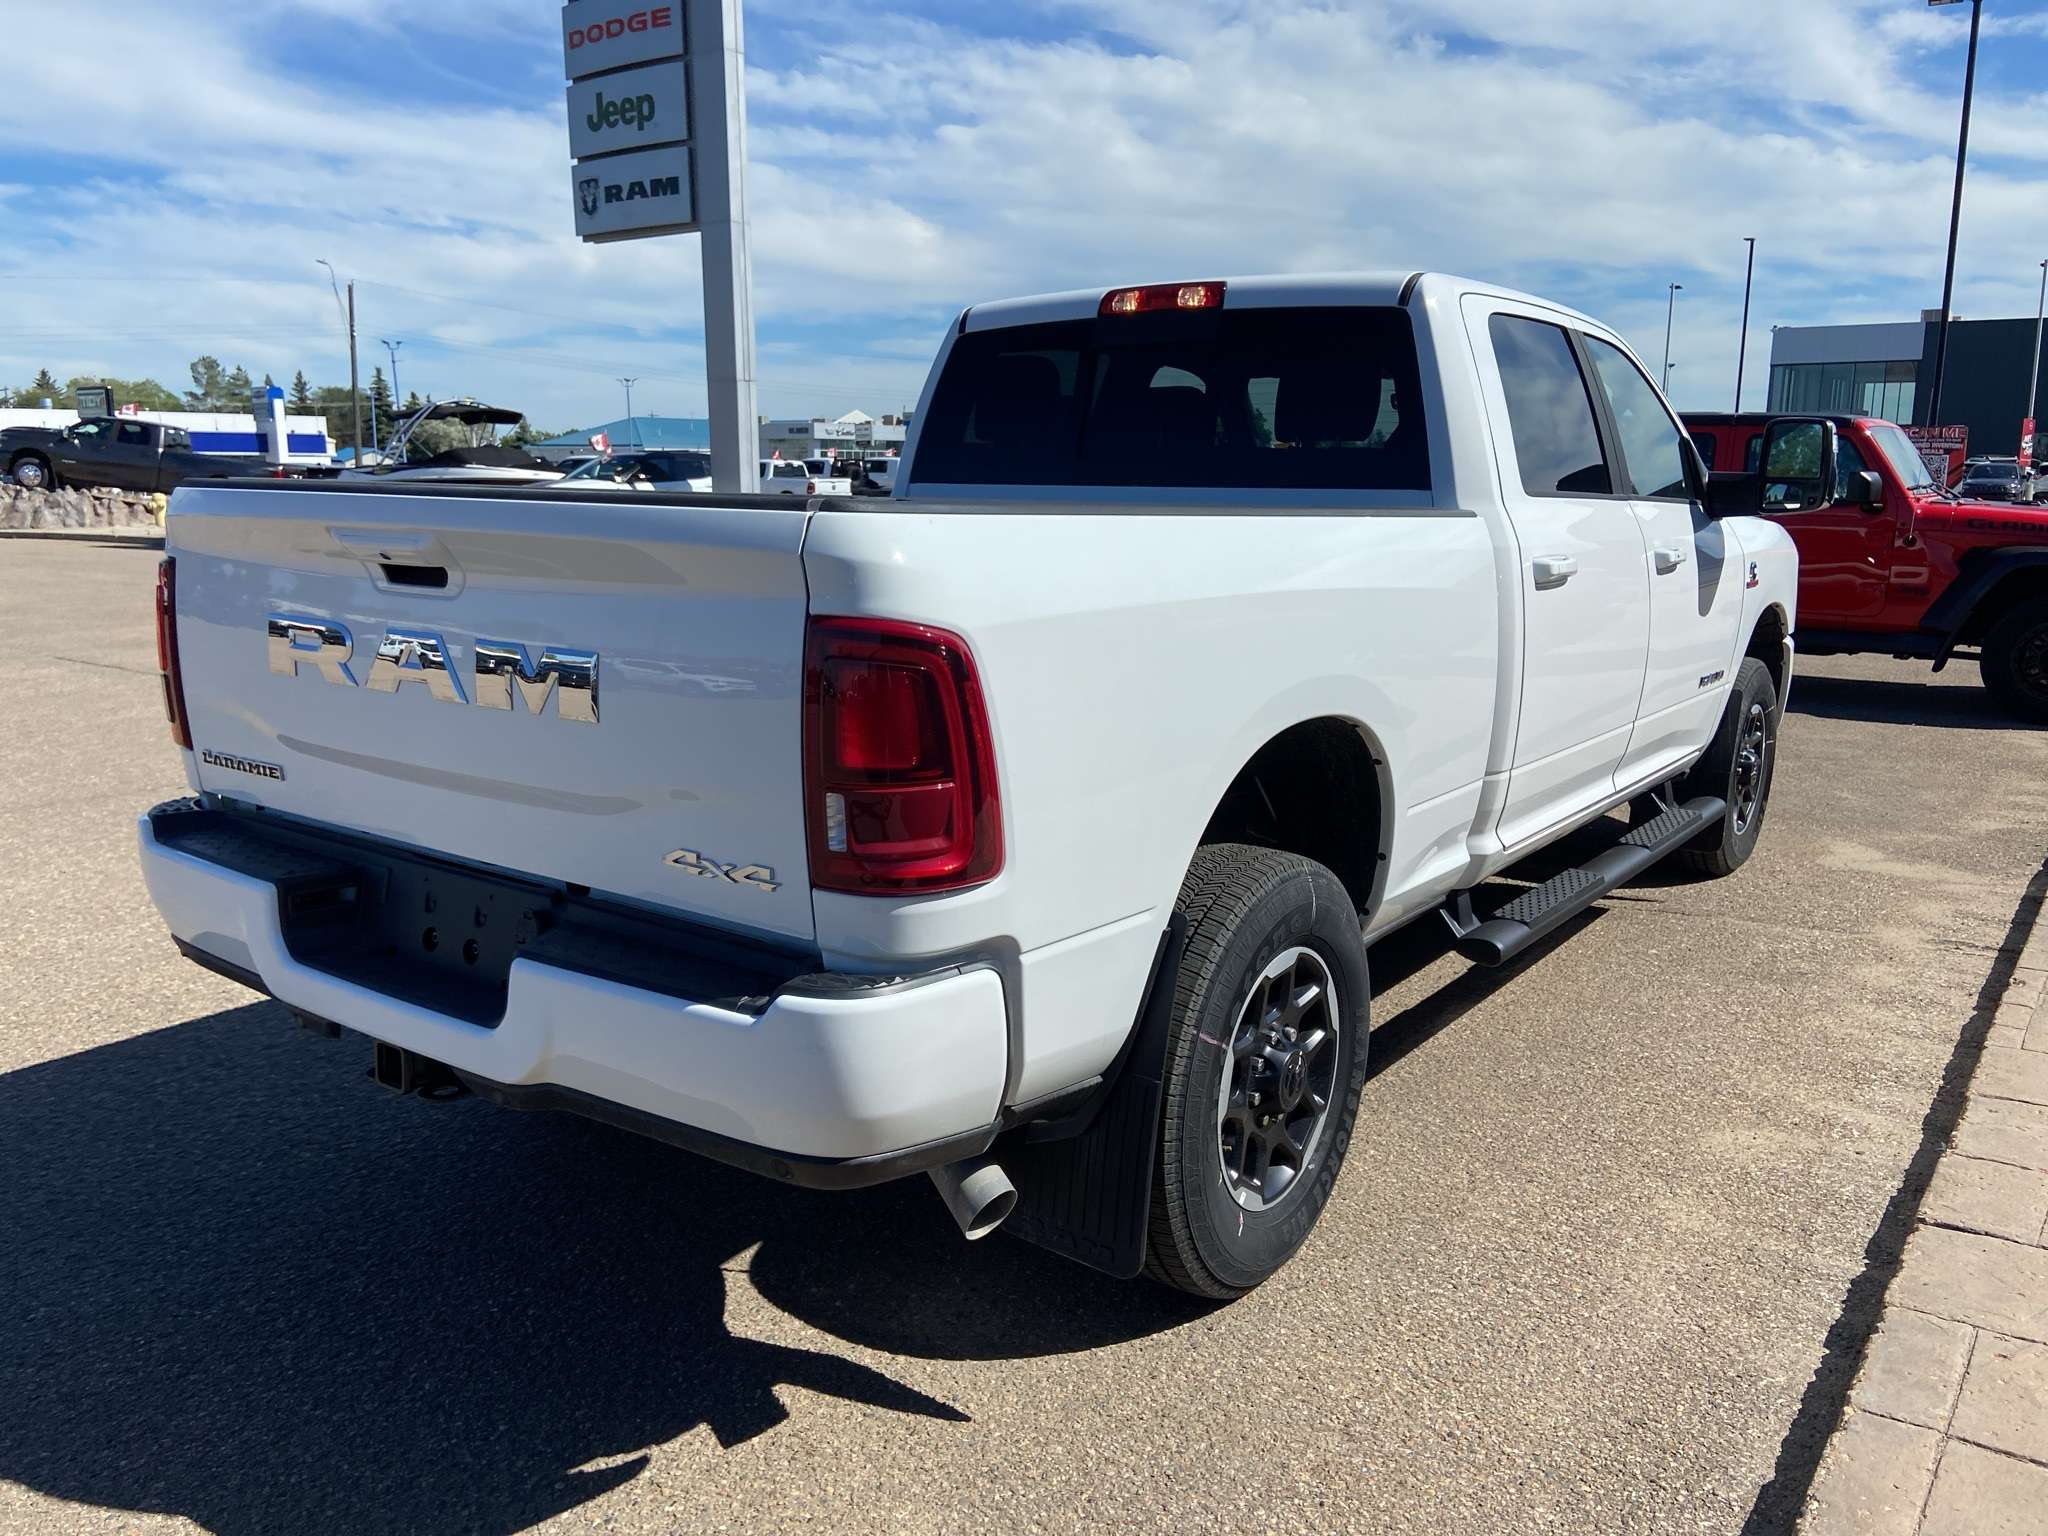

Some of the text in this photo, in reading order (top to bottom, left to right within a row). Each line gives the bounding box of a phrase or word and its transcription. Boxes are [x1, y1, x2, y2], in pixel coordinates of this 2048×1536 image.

[568, 7, 672, 49] DODGE
[586, 92, 656, 133] Jeep
[604, 176, 680, 204] RAM
[268, 612, 600, 724] RAM
[202, 750, 284, 781] LARAMIE
